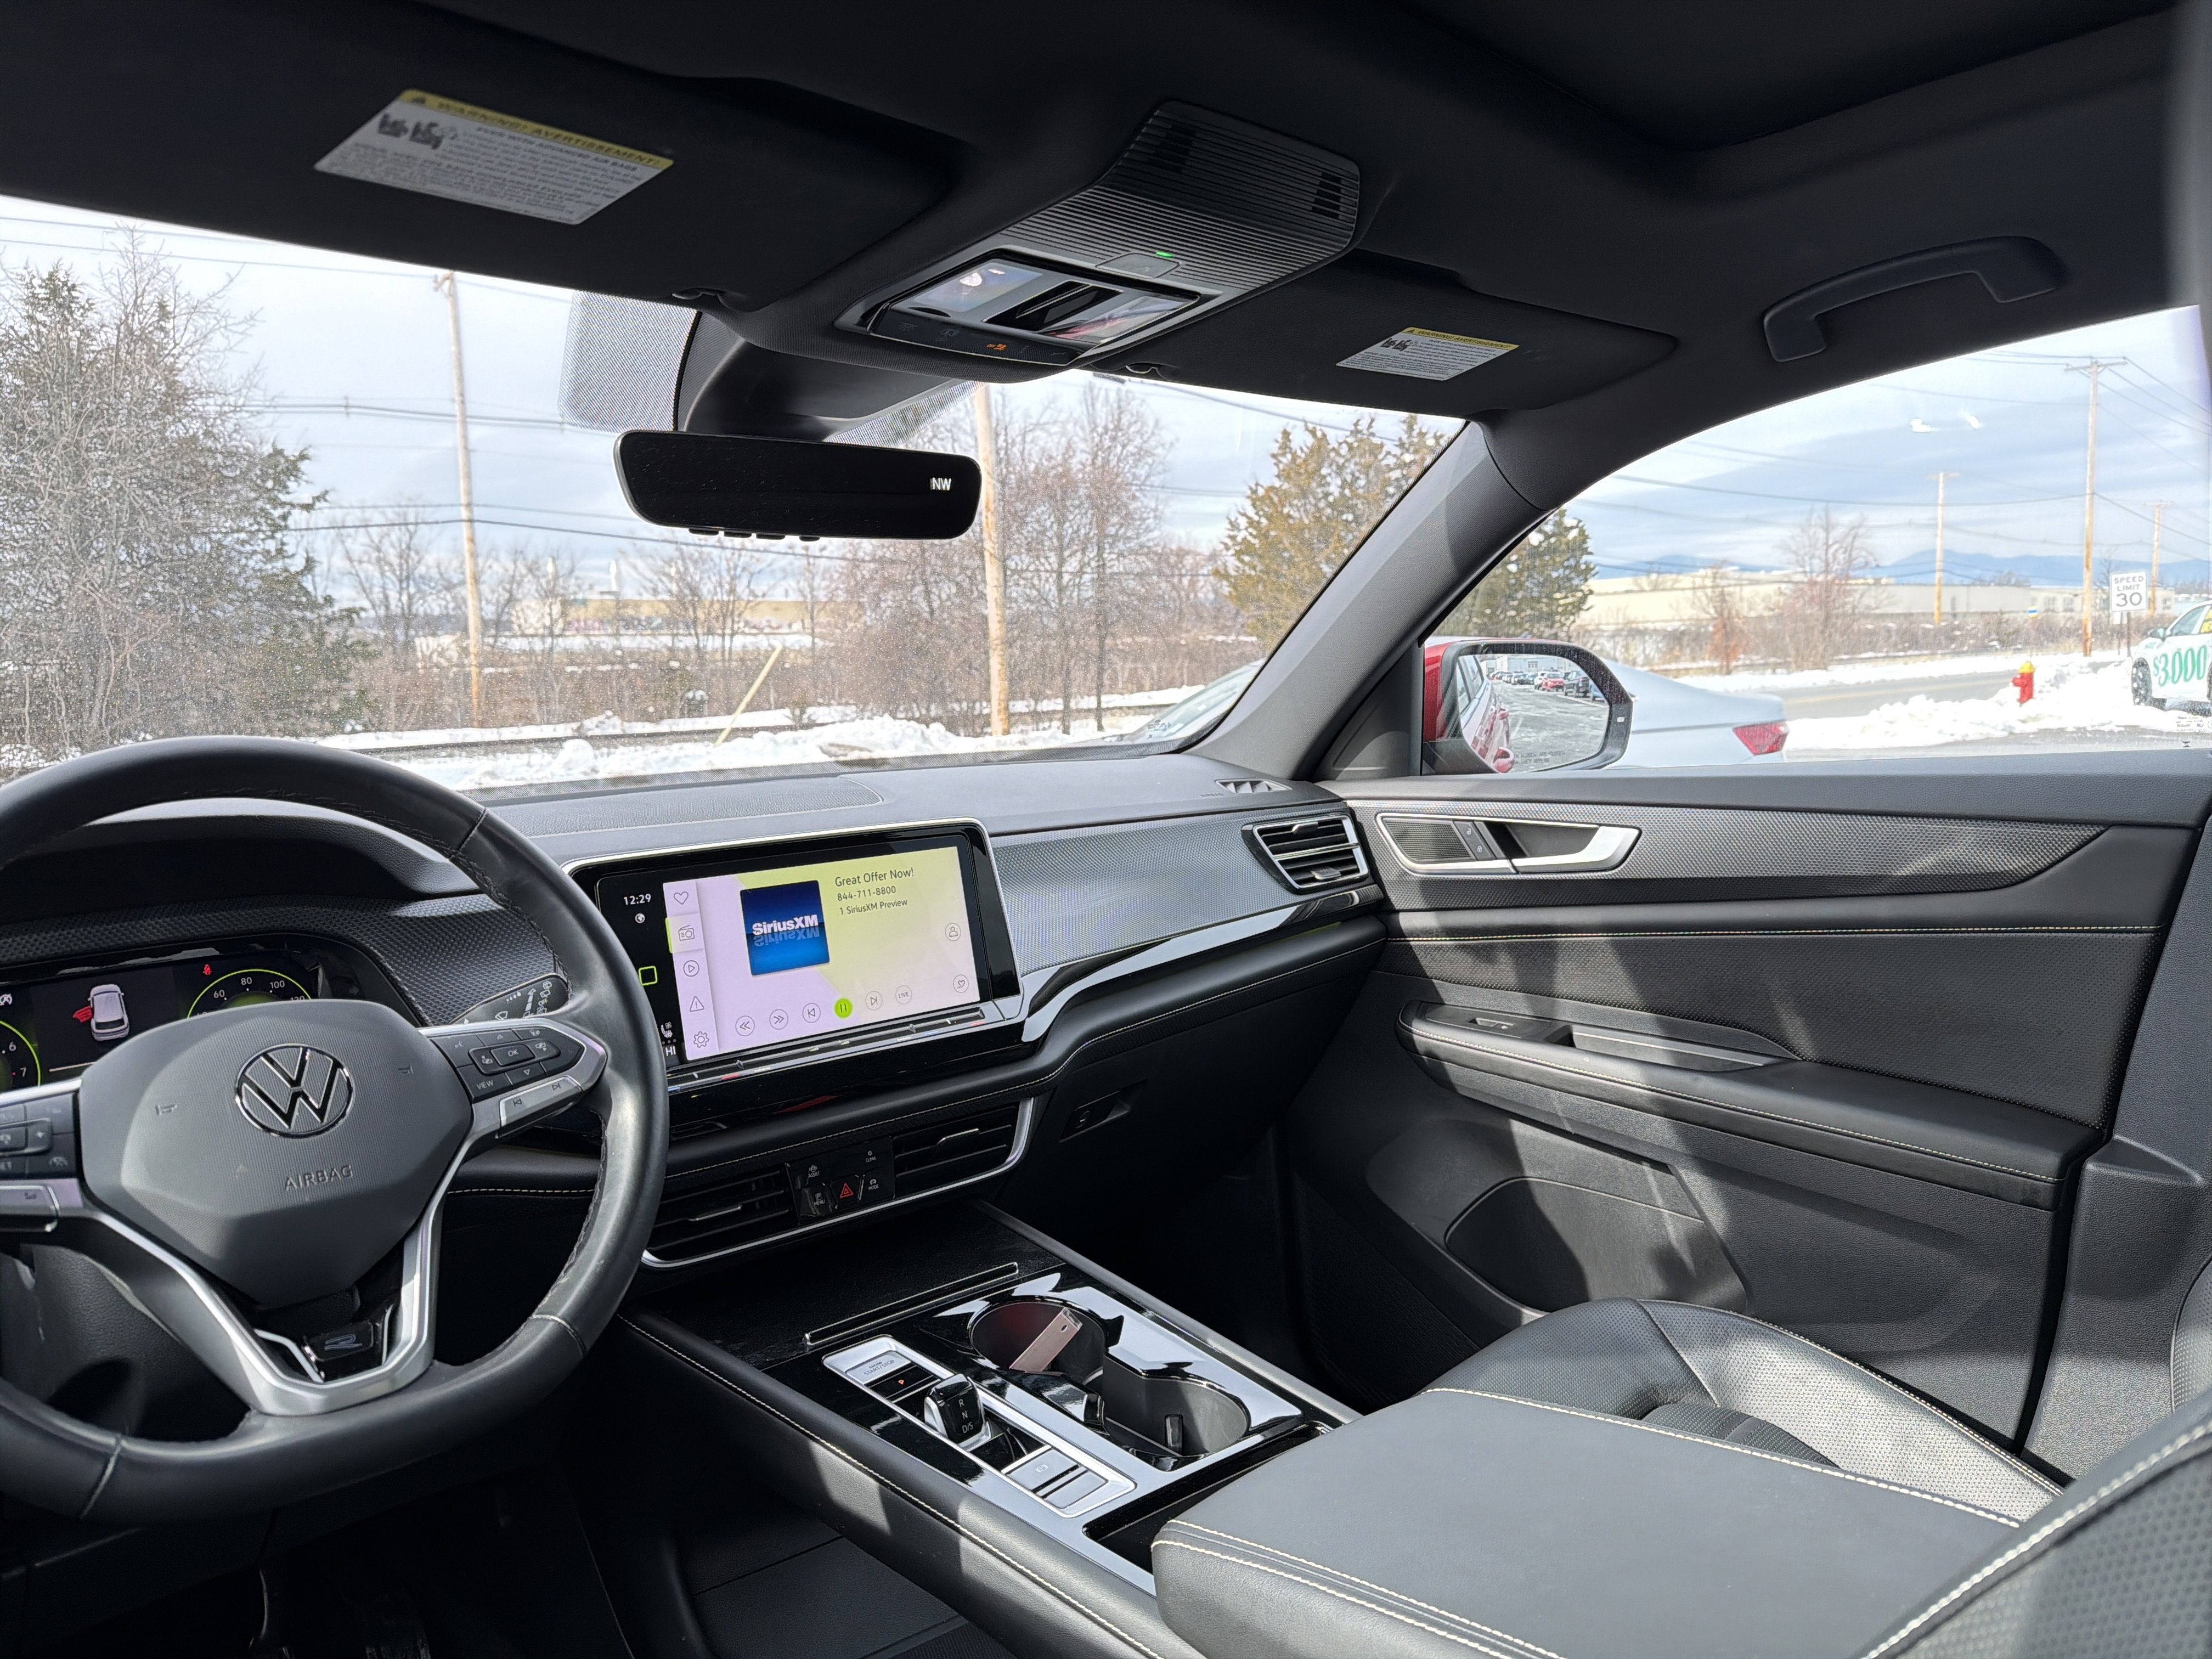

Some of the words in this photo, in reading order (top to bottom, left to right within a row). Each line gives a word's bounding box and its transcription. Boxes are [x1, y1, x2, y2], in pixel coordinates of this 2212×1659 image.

[536, 127, 662, 166] AVERTISSEMENT!
[1418, 331, 1454, 340] WARNING!
[1454, 337, 1513, 349] AVERTISSEMENT!
[932, 477, 952, 490] NW
[2114, 575, 2144, 584] SPEED
[2115, 592, 2142, 607] 30
[835, 875, 861, 887] Great
[864, 871, 887, 883] Offer
[890, 867, 914, 879] Now!
[623, 893, 651, 905] 12:29
[837, 885, 896, 901] 844-711-8800
[847, 902, 878, 915] SiriusXM
[879, 899, 908, 909] Preview
[752, 914, 819, 935] SiriusXM
[241, 977, 252, 985] 80
[269, 980, 285, 989] 100
[213, 990, 225, 998] 60
[538, 998, 548, 1006] OFF
[9, 1042, 16, 1051] 6
[665, 1046, 676, 1057] HI
[20, 1067, 26, 1077] 7
[476, 1080, 494, 1090] VIEW
[286, 1165, 353, 1191] AIRBAG
[864, 1359, 895, 1376] START/STOP
[958, 1398, 964, 1407] R
[962, 1410, 968, 1420] N
[962, 1421, 974, 1434] D/S
